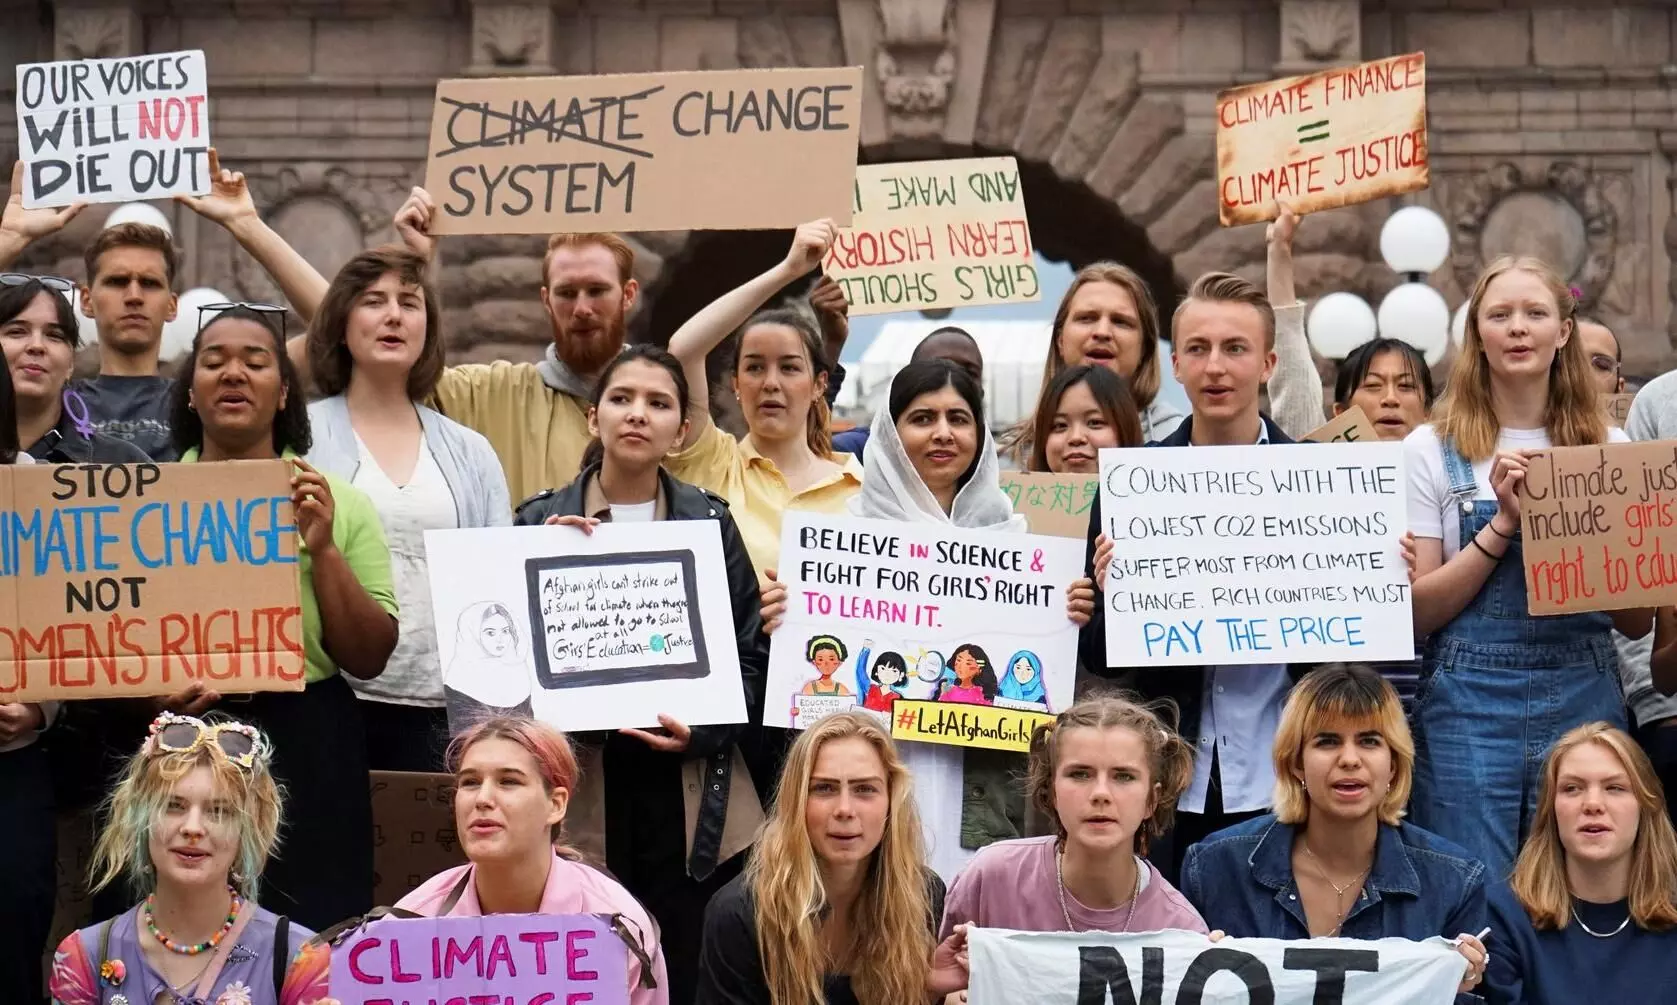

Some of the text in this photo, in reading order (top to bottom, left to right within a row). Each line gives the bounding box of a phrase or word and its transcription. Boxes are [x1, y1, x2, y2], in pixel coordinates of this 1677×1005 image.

[22, 64, 94, 110] OUR
[1220, 59, 1422, 128] CLIMATE FINANCE
[138, 95, 205, 141] NOT
[440, 85, 853, 152] CLIMATE CHANGE
[129, 146, 208, 194] OUT
[443, 161, 636, 217] SYSTEM
[968, 171, 1018, 203] AND
[1222, 128, 1425, 208] CLIMATE JUSTICE
[880, 176, 956, 210] MAKE
[826, 220, 1030, 270] LEARN HISTORY
[955, 263, 1039, 301] GIRLS
[52, 463, 160, 500] STOP
[1107, 463, 1396, 497] COUNTRIES WITH THE
[1524, 449, 1628, 501] Climate
[0, 496, 299, 577] IMATE CHANGE
[1110, 511, 1388, 540] LOWEST CO2 EMISSIONS
[1528, 493, 1674, 547] include girls'
[800, 526, 1045, 573] BELIEVE IN SCIENCE &
[1111, 551, 1385, 580] SUFFER MOST FROM CLIMATE
[65, 577, 146, 613] NOT
[544, 575, 585, 599] Afghan
[587, 571, 608, 600] girls
[633, 571, 658, 588] strike
[800, 561, 1055, 607] FIGHT FOR GIRLS' RIGHT
[1531, 545, 1595, 605] right
[1604, 545, 1629, 594] to
[636, 597, 659, 610] when
[803, 591, 943, 628] TO LEARN IT.
[1112, 584, 1408, 613] CHANGE. RICH COUNTRIES MUST
[160, 606, 305, 683] RIGHTS
[547, 619, 566, 634] not
[572, 615, 609, 631] allowed
[614, 612, 625, 626] to
[628, 618, 642, 631] go
[646, 612, 656, 625] to
[595, 628, 628, 640] at all
[1143, 616, 1366, 657] PAY THE PRICE
[348, 930, 598, 984] CLIMATE
